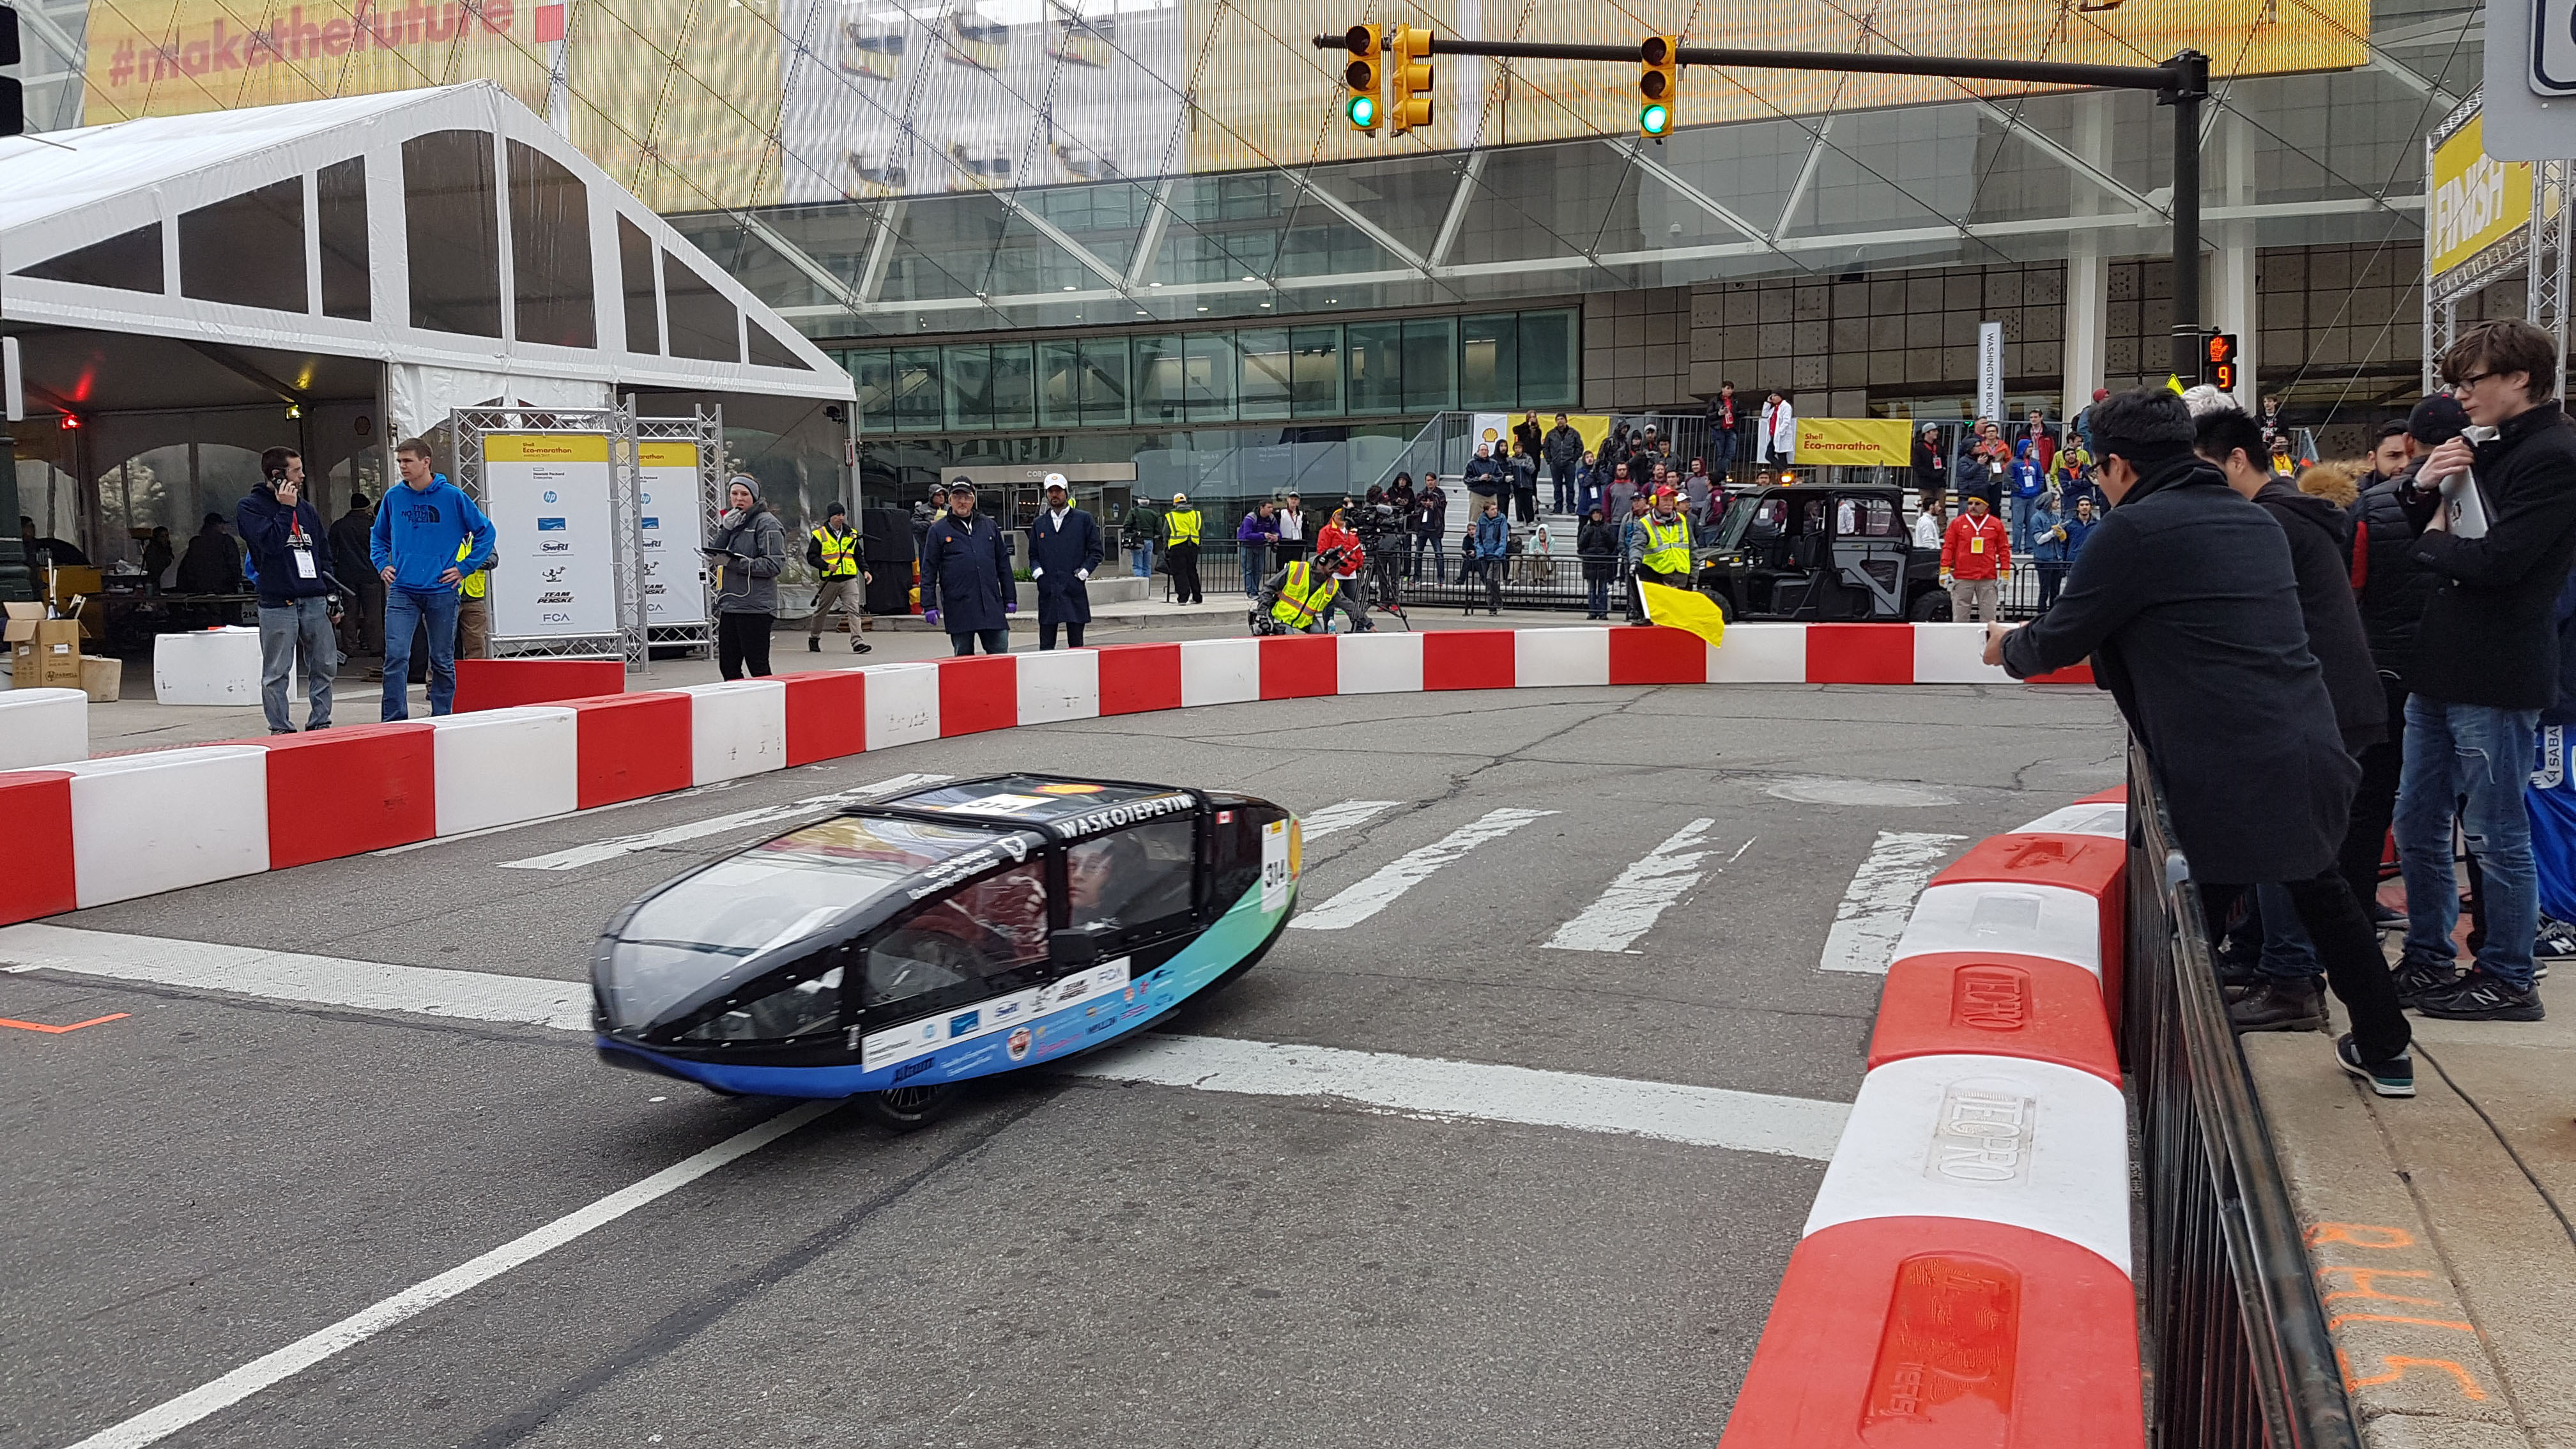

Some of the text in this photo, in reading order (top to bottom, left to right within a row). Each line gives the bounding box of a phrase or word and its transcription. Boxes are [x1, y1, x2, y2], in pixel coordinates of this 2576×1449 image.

[109, 0, 514, 87] #makethefuture
[2435, 153, 2506, 259] FINISH
[2219, 366, 2228, 388] 9
[1804, 441, 1880, 450] Eco-marathon
[544, 490, 557, 503] hp
[543, 613, 570, 622] FCA
[1265, 859, 1285, 887] 314
